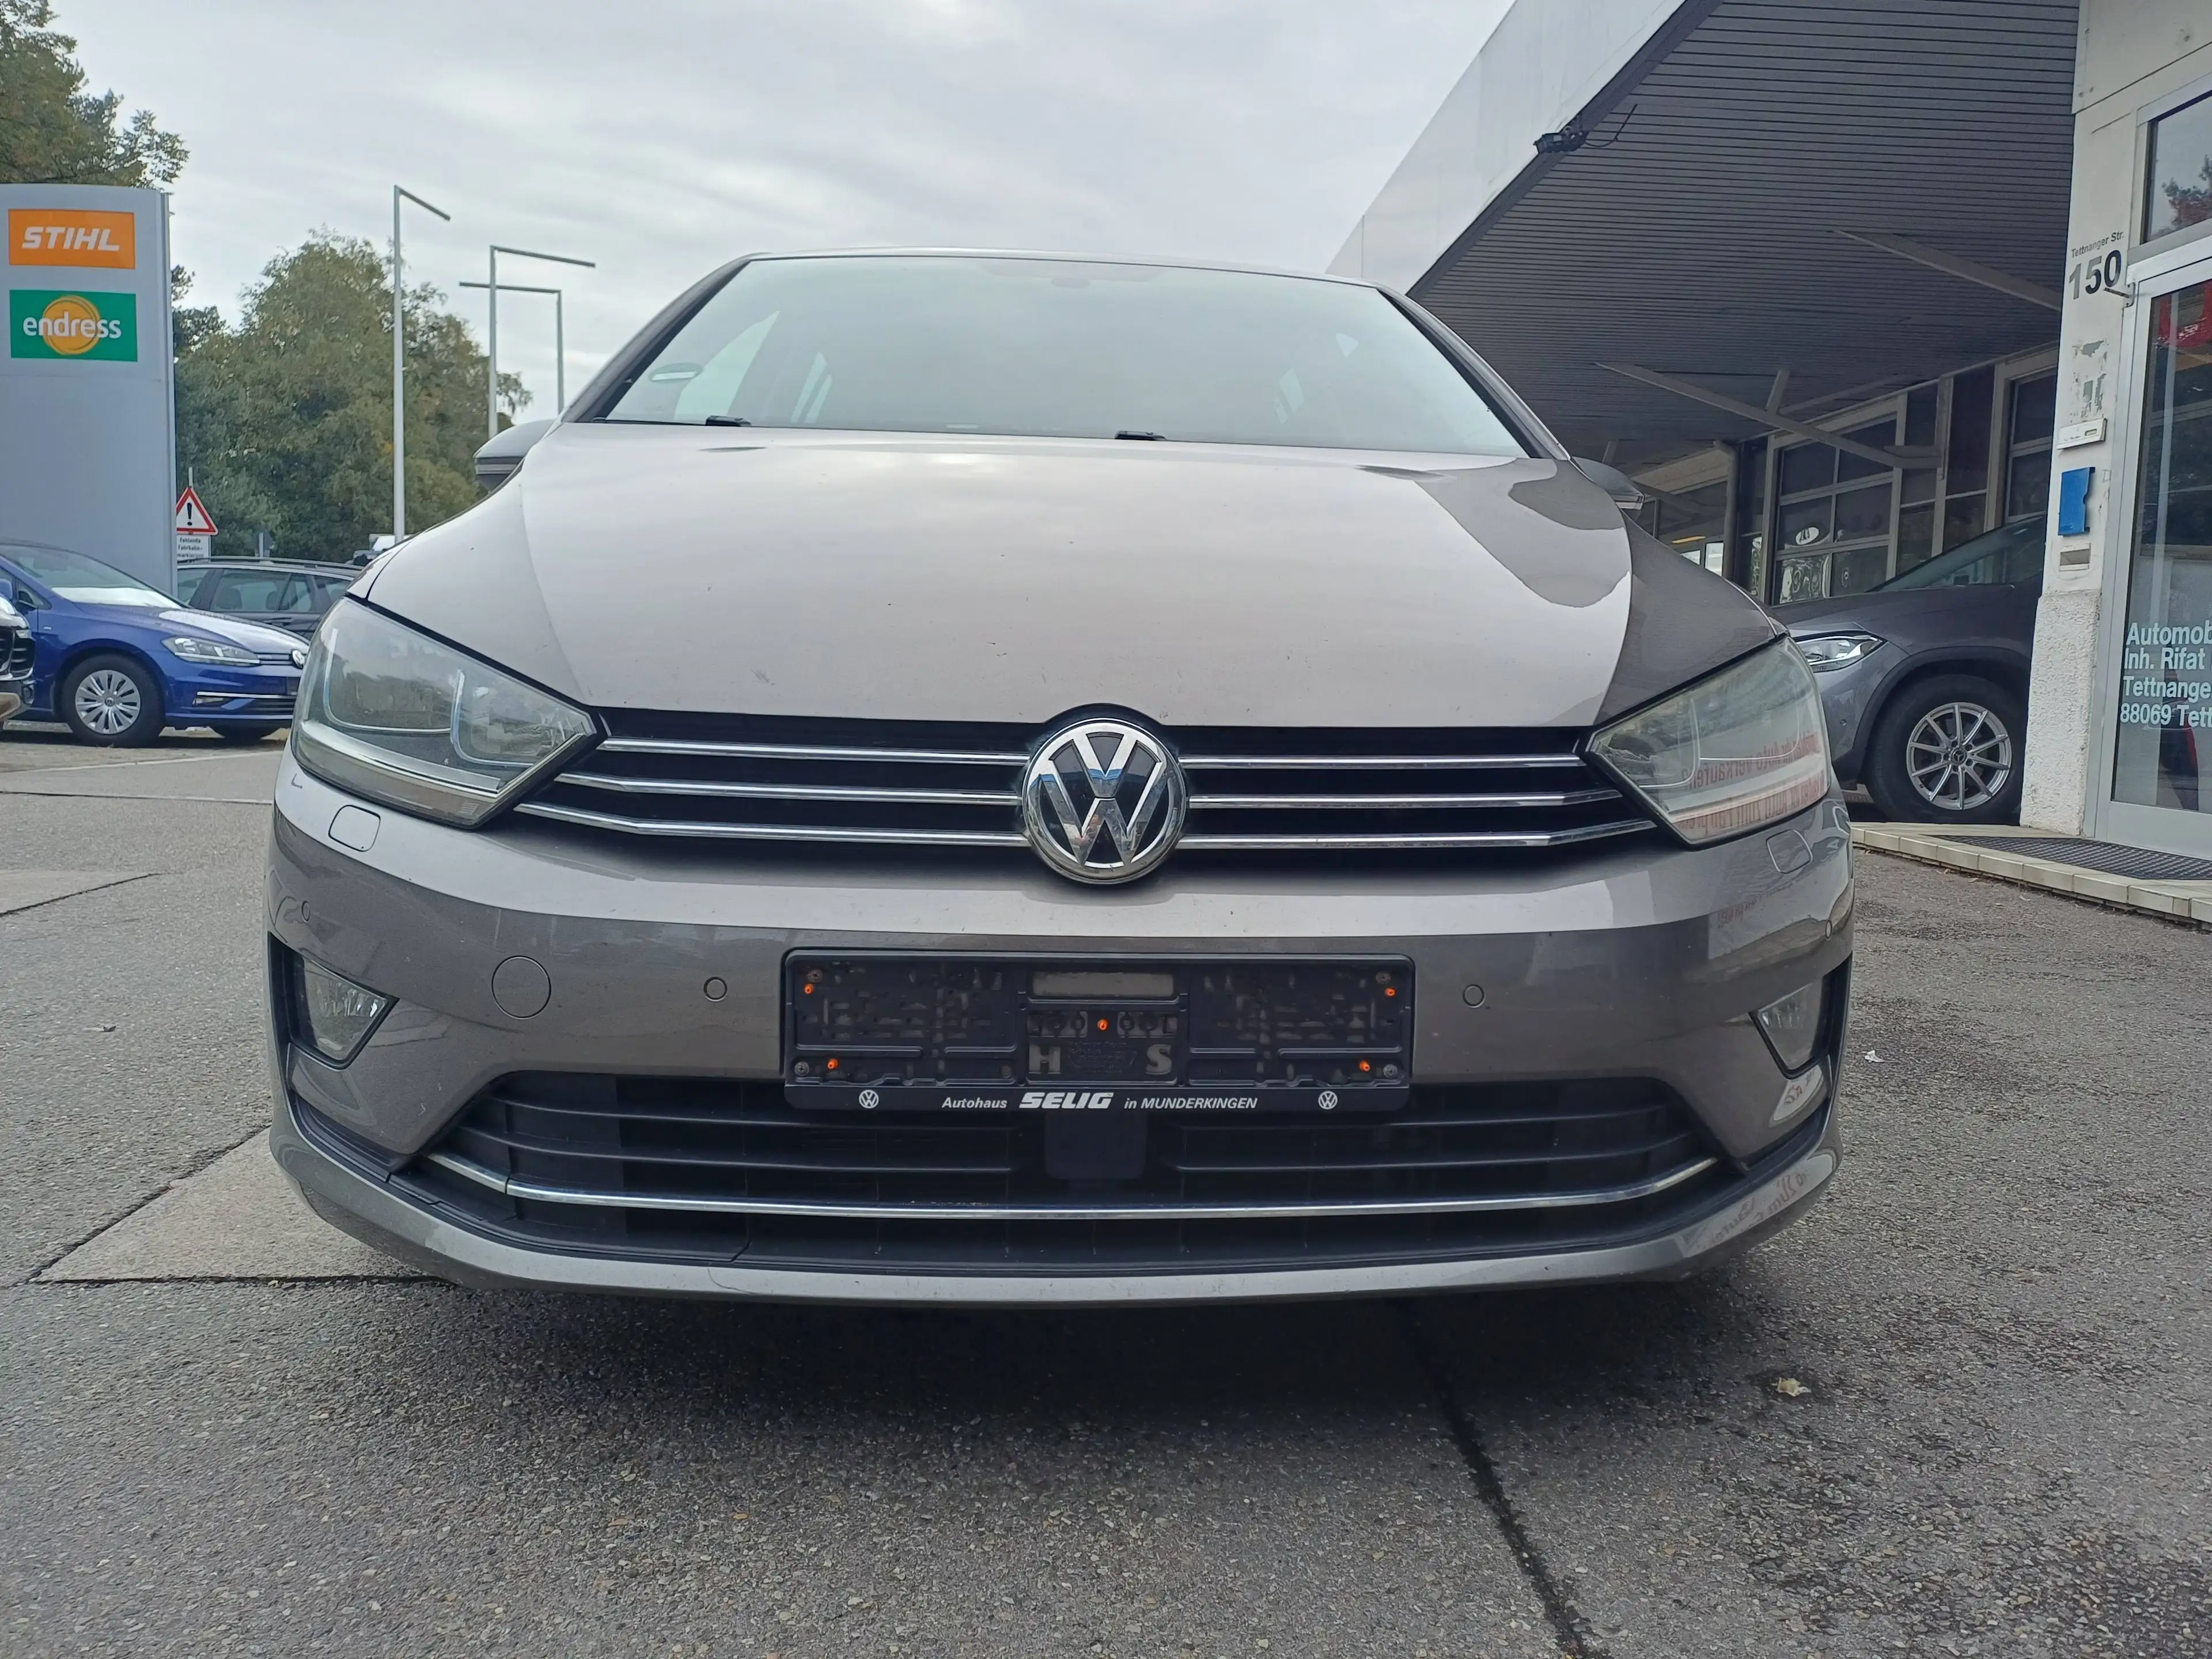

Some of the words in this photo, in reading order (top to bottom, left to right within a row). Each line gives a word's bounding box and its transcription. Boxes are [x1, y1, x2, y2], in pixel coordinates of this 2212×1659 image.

[21, 226, 120, 252] STIHL
[2071, 237, 2109, 258] Tettnanger
[2111, 231, 2124, 242] Str.
[2069, 249, 2122, 300] 150
[22, 310, 122, 339] endress
[2126, 620, 2212, 645] Automob
[2124, 647, 2154, 669] Inh.
[2161, 647, 2205, 670] Rifat
[2123, 676, 2212, 703] Tettnange
[2120, 703, 2172, 725] 88069
[1028, 724, 1178, 873] VW
[859, 1089, 879, 1108] VW
[942, 1097, 1007, 1109] Autohaus
[1019, 1092, 1113, 1109] SELIG
[1124, 1097, 1137, 1109] in
[1141, 1097, 1257, 1109] MUNDERKINGEN
[1318, 1090, 1338, 1109] VW
